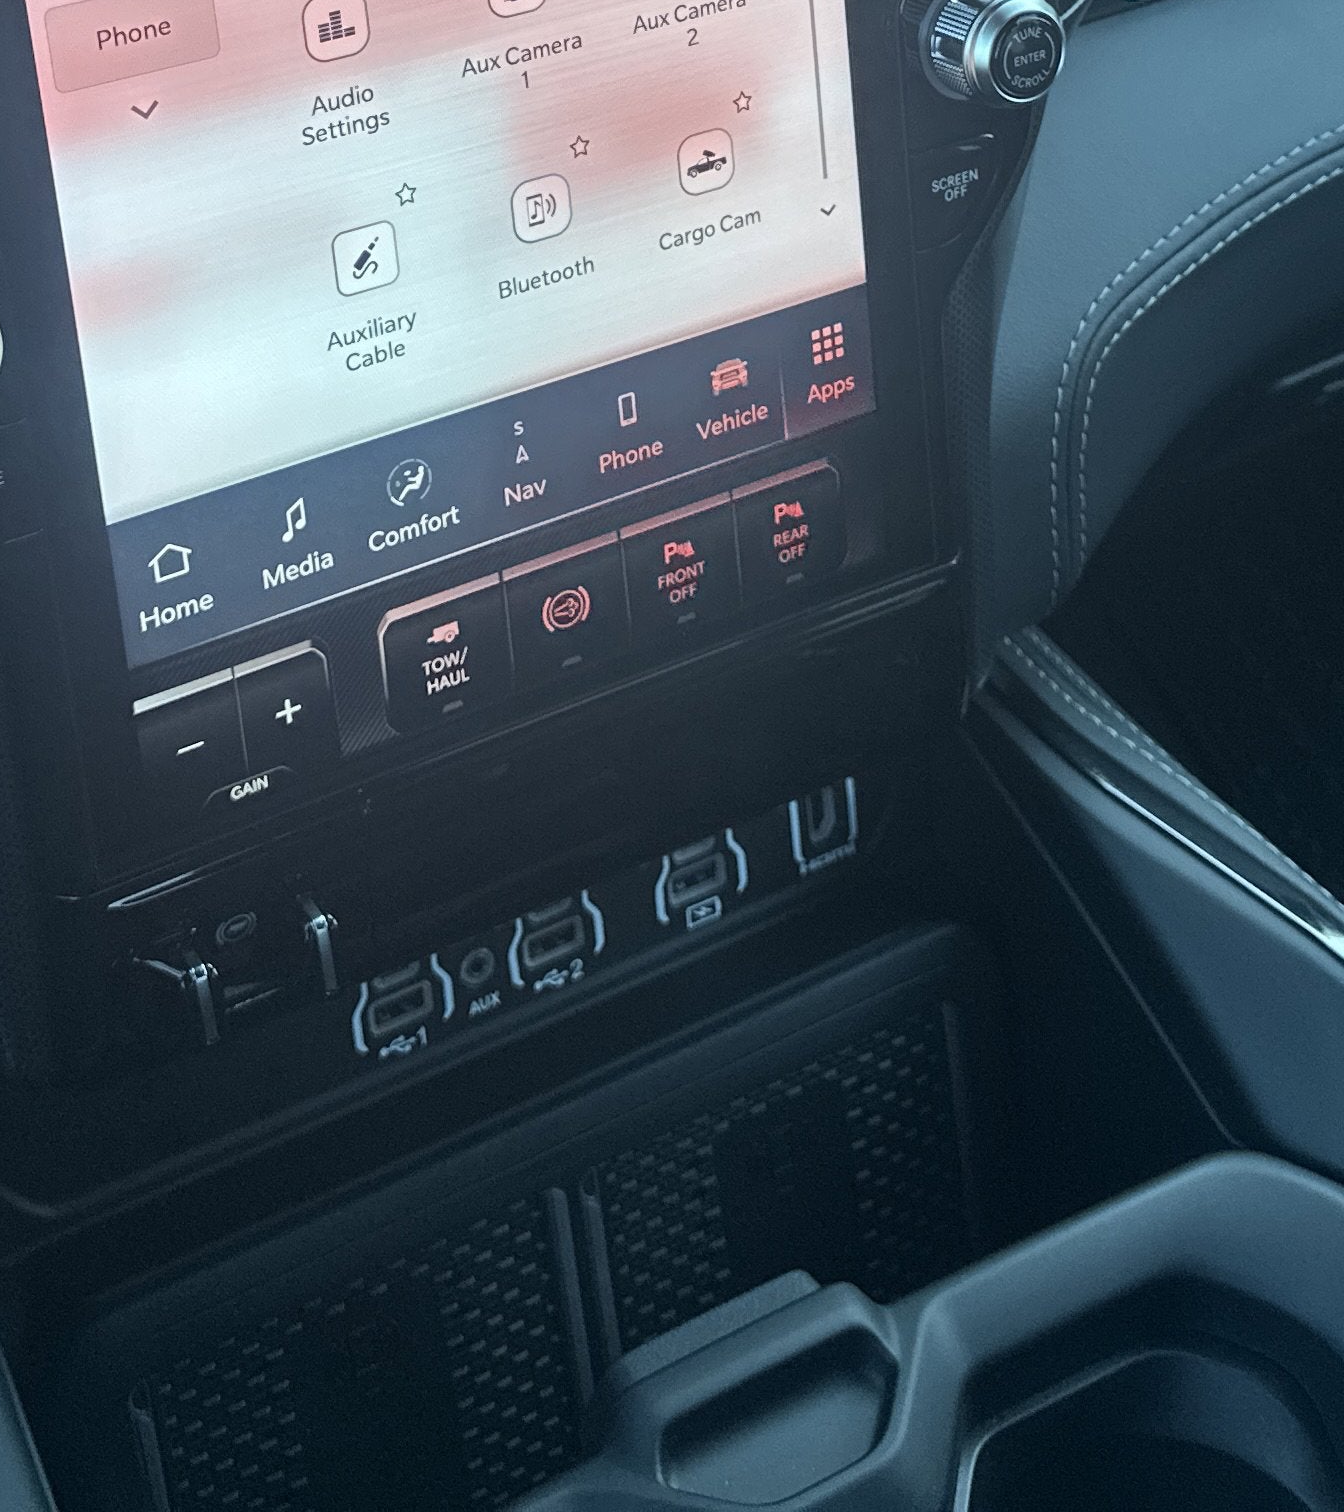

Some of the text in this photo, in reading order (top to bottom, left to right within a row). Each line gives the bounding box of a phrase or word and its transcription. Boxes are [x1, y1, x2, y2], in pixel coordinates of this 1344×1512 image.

[96, 18, 172, 50] Phone
[633, 11, 670, 34] Aux
[1013, 27, 1043, 43] TUNE
[687, 29, 699, 47] 2
[462, 34, 583, 78] Aux Camera
[1014, 50, 1046, 67] ENTER
[520, 71, 529, 89] 1
[1011, 69, 1051, 88] SCROLL
[311, 85, 375, 116] Audio
[302, 109, 391, 146] Settings
[931, 169, 979, 194] SCREEN
[944, 185, 968, 203] OFF
[659, 208, 762, 252] Cargo Cam
[498, 256, 595, 300] Bluetooth
[327, 309, 417, 351] Auxiliary
[345, 341, 406, 372] Cable
[808, 375, 855, 404] Apps
[696, 402, 769, 441] Vehicle
[599, 439, 664, 474] Phone
[503, 479, 547, 507] Nav
[367, 505, 460, 553] Comfort
[773, 524, 809, 547] REAR
[778, 543, 806, 563] OFF
[263, 550, 335, 590] Media
[657, 560, 705, 589] FRONT
[669, 582, 697, 604] OFF
[139, 592, 214, 632] Home
[422, 647, 469, 676] TOW/
[426, 670, 470, 696] HAUL
[229, 775, 269, 801] GAIN
[468, 989, 501, 1017] AUX
